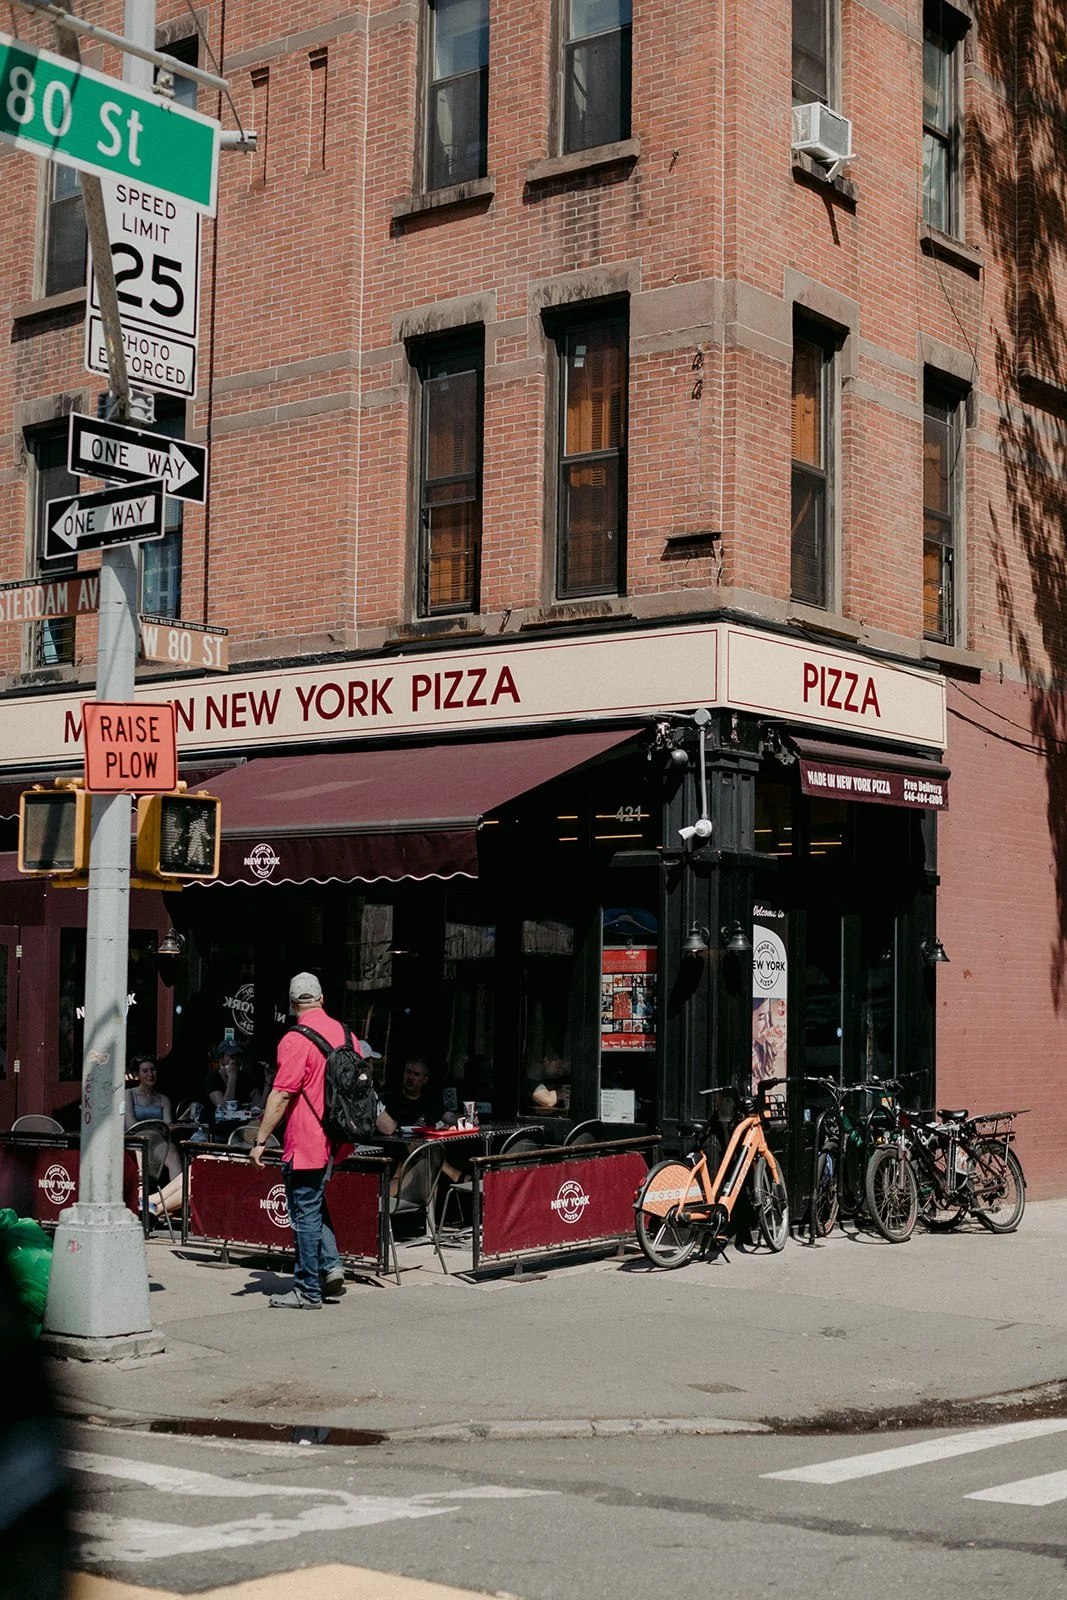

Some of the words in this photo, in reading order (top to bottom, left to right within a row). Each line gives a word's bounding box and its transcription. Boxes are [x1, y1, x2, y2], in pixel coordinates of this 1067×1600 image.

[6, 66, 73, 137] 80
[96, 101, 144, 167] St
[116, 184, 176, 220] SPEED
[122, 212, 170, 244] LIMIT
[110, 242, 184, 317] 25
[91, 438, 129, 467] ONE
[148, 452, 186, 480] WAY
[64, 510, 95, 536] ONE
[112, 500, 147, 528] WAY
[142, 625, 159, 658] W
[168, 629, 192, 663] 80
[202, 634, 224, 667] ST
[167, 697, 195, 733] N
[205, 688, 282, 731] NEW
[295, 675, 394, 722] YORK
[412, 665, 521, 713] PIZZA
[803, 662, 881, 717] PIZZA
[100, 715, 160, 743] RAISE
[106, 751, 157, 779] PLOW
[807, 770, 827, 787] MADE
[827, 773, 835, 788] IN
[836, 774, 852, 790] NEW
[853, 776, 872, 793] YORK
[872, 779, 891, 795] PIZZA
[904, 778, 918, 791] Free
[918, 780, 942, 795] Delivery
[616, 805, 642, 822] 421
[244, 857, 261, 866] NEW
[262, 856, 280, 865] YORK
[752, 960, 765, 971] EW
[766, 961, 786, 972] YORK
[38, 1179, 56, 1189] NEW
[56, 1180, 76, 1191] YORK
[652, 1190, 681, 1200] JOCO
[260, 1199, 280, 1210] NEW
[551, 1198, 569, 1210] NEW
[570, 1195, 590, 1207] YORK
